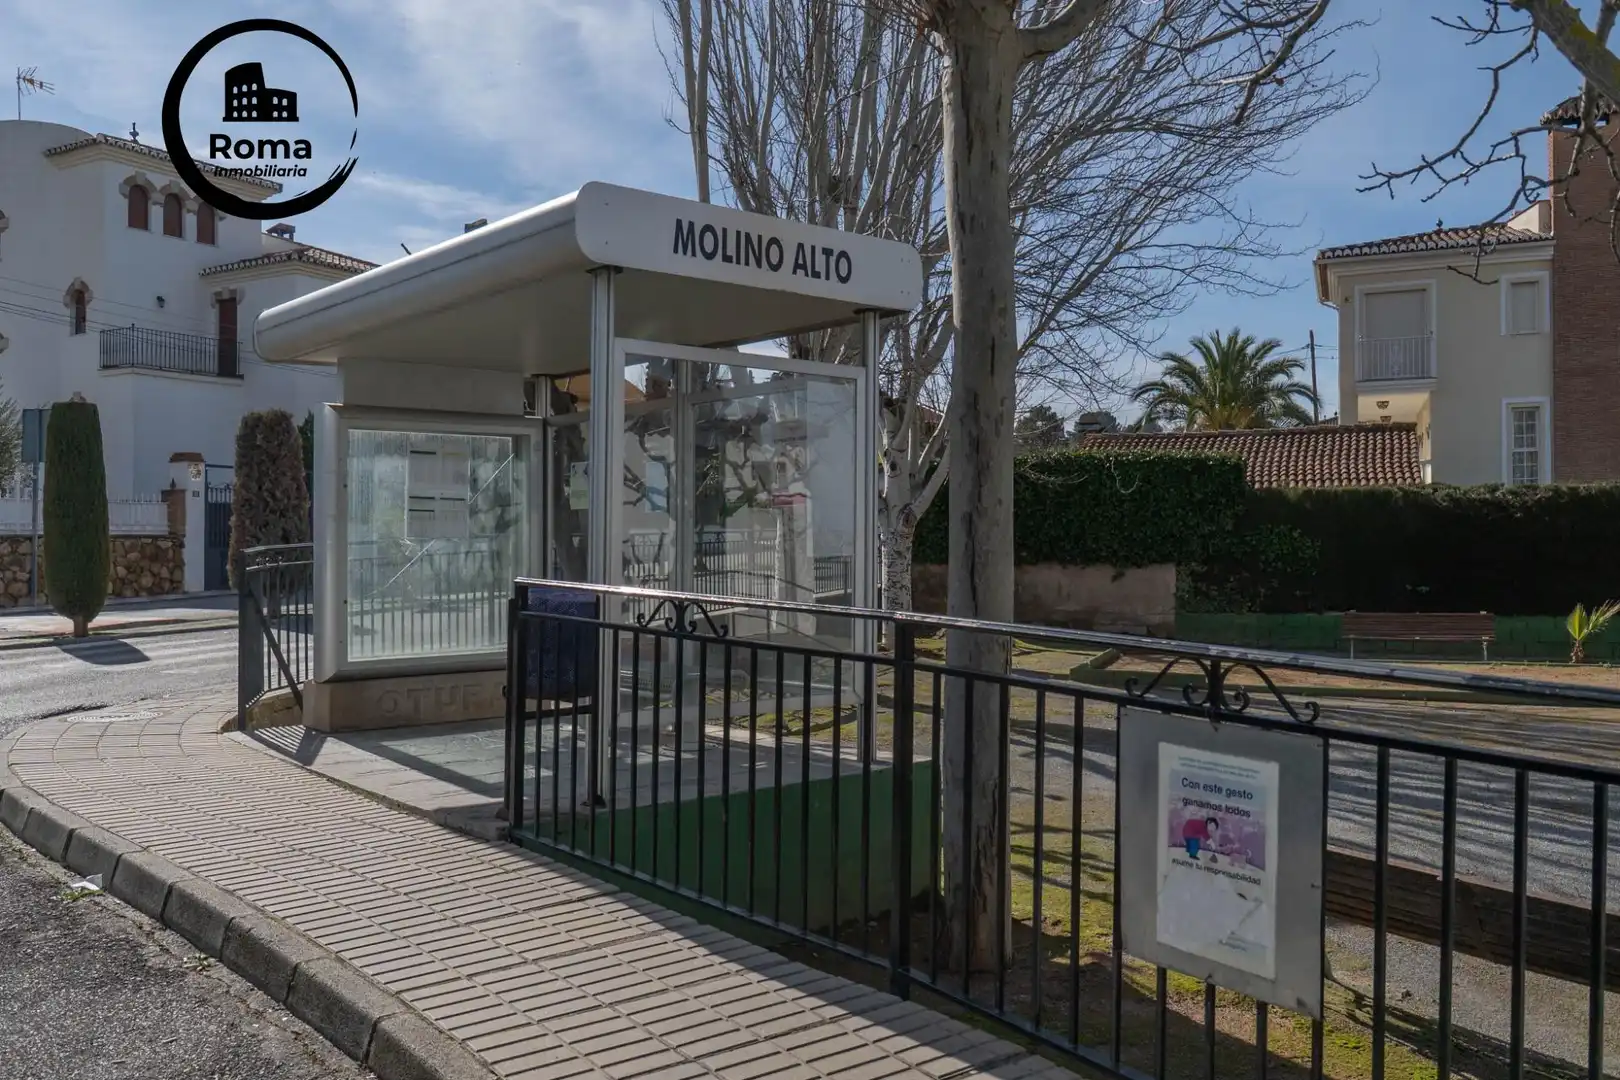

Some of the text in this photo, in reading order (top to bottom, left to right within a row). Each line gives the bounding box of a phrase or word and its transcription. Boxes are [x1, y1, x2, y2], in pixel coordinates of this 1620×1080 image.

[672, 217, 853, 285] MOLINO ALTO
[1181, 777, 1253, 800] Con este gesto
[1182, 796, 1251, 818] ganamos todos
